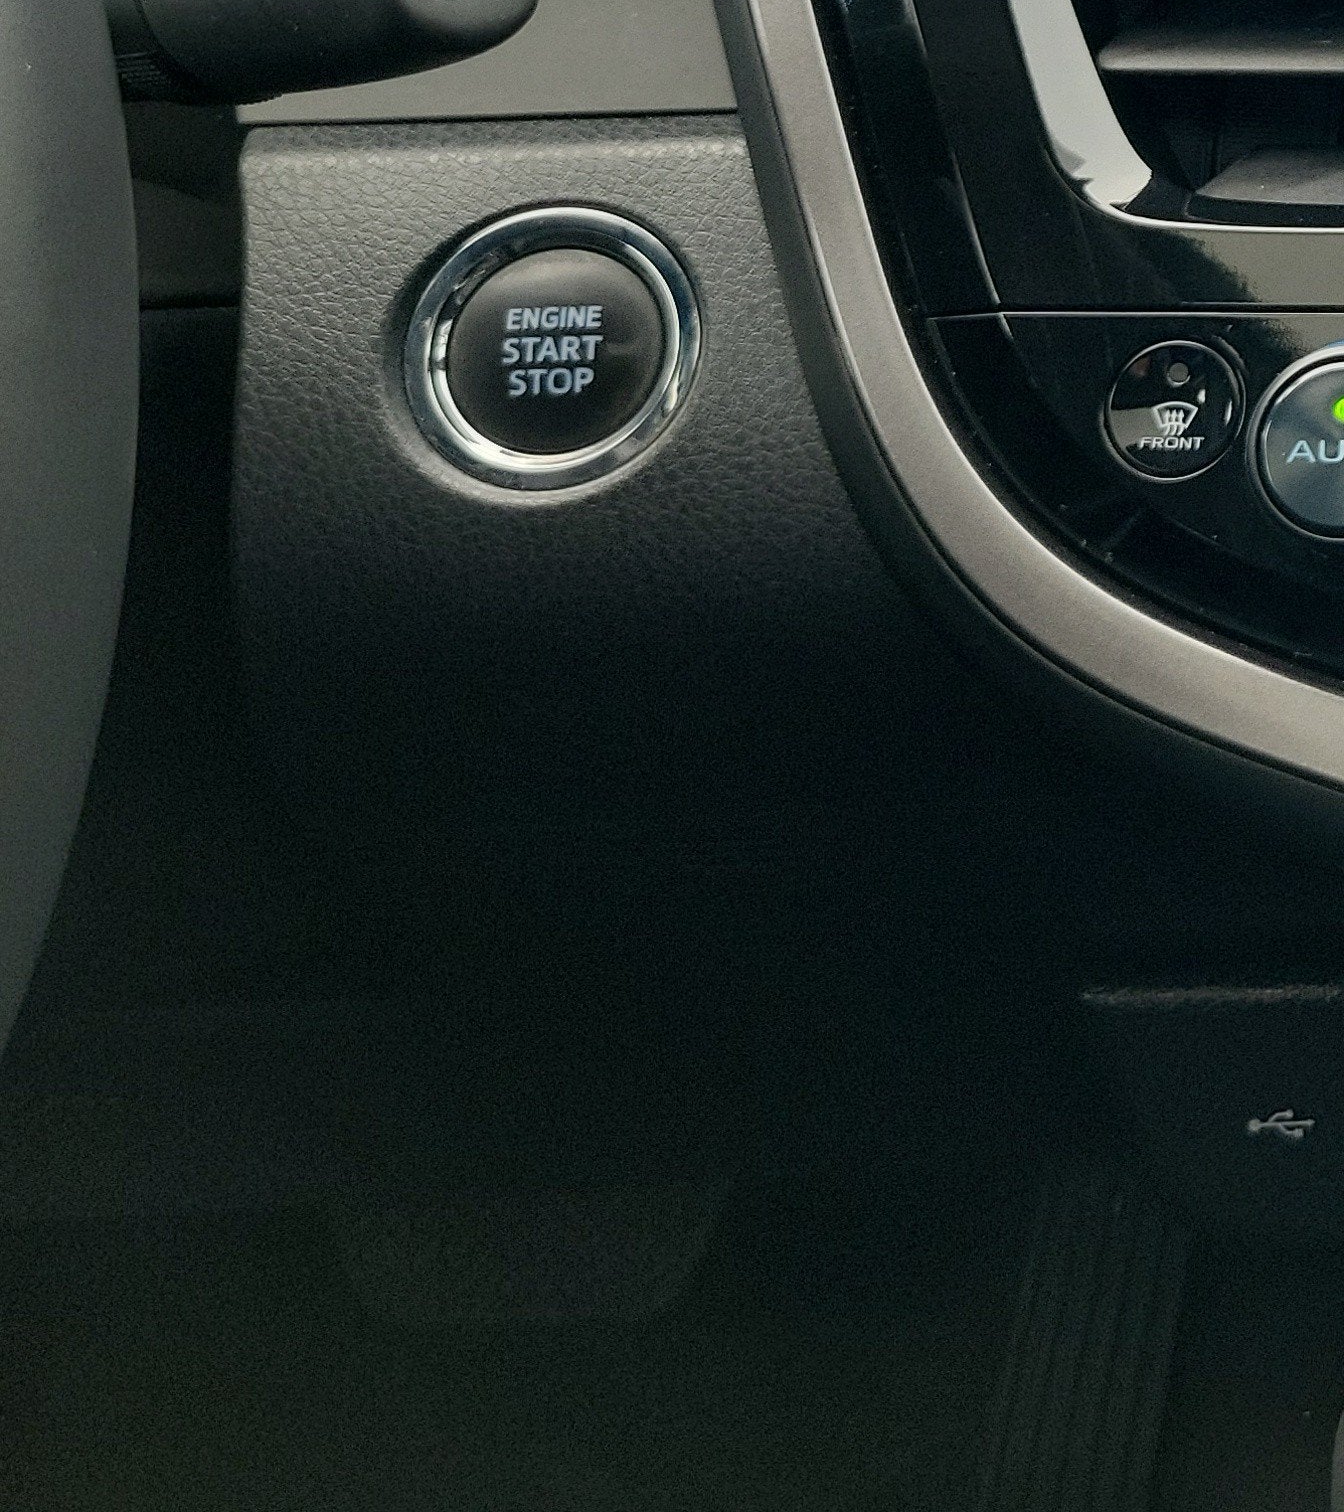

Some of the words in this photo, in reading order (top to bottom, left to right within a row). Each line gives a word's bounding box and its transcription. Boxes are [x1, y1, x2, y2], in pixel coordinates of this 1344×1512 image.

[505, 305, 603, 331] ENGINE
[502, 335, 604, 364] START
[508, 367, 595, 397] STOP
[1140, 436, 1205, 450] FRONT
